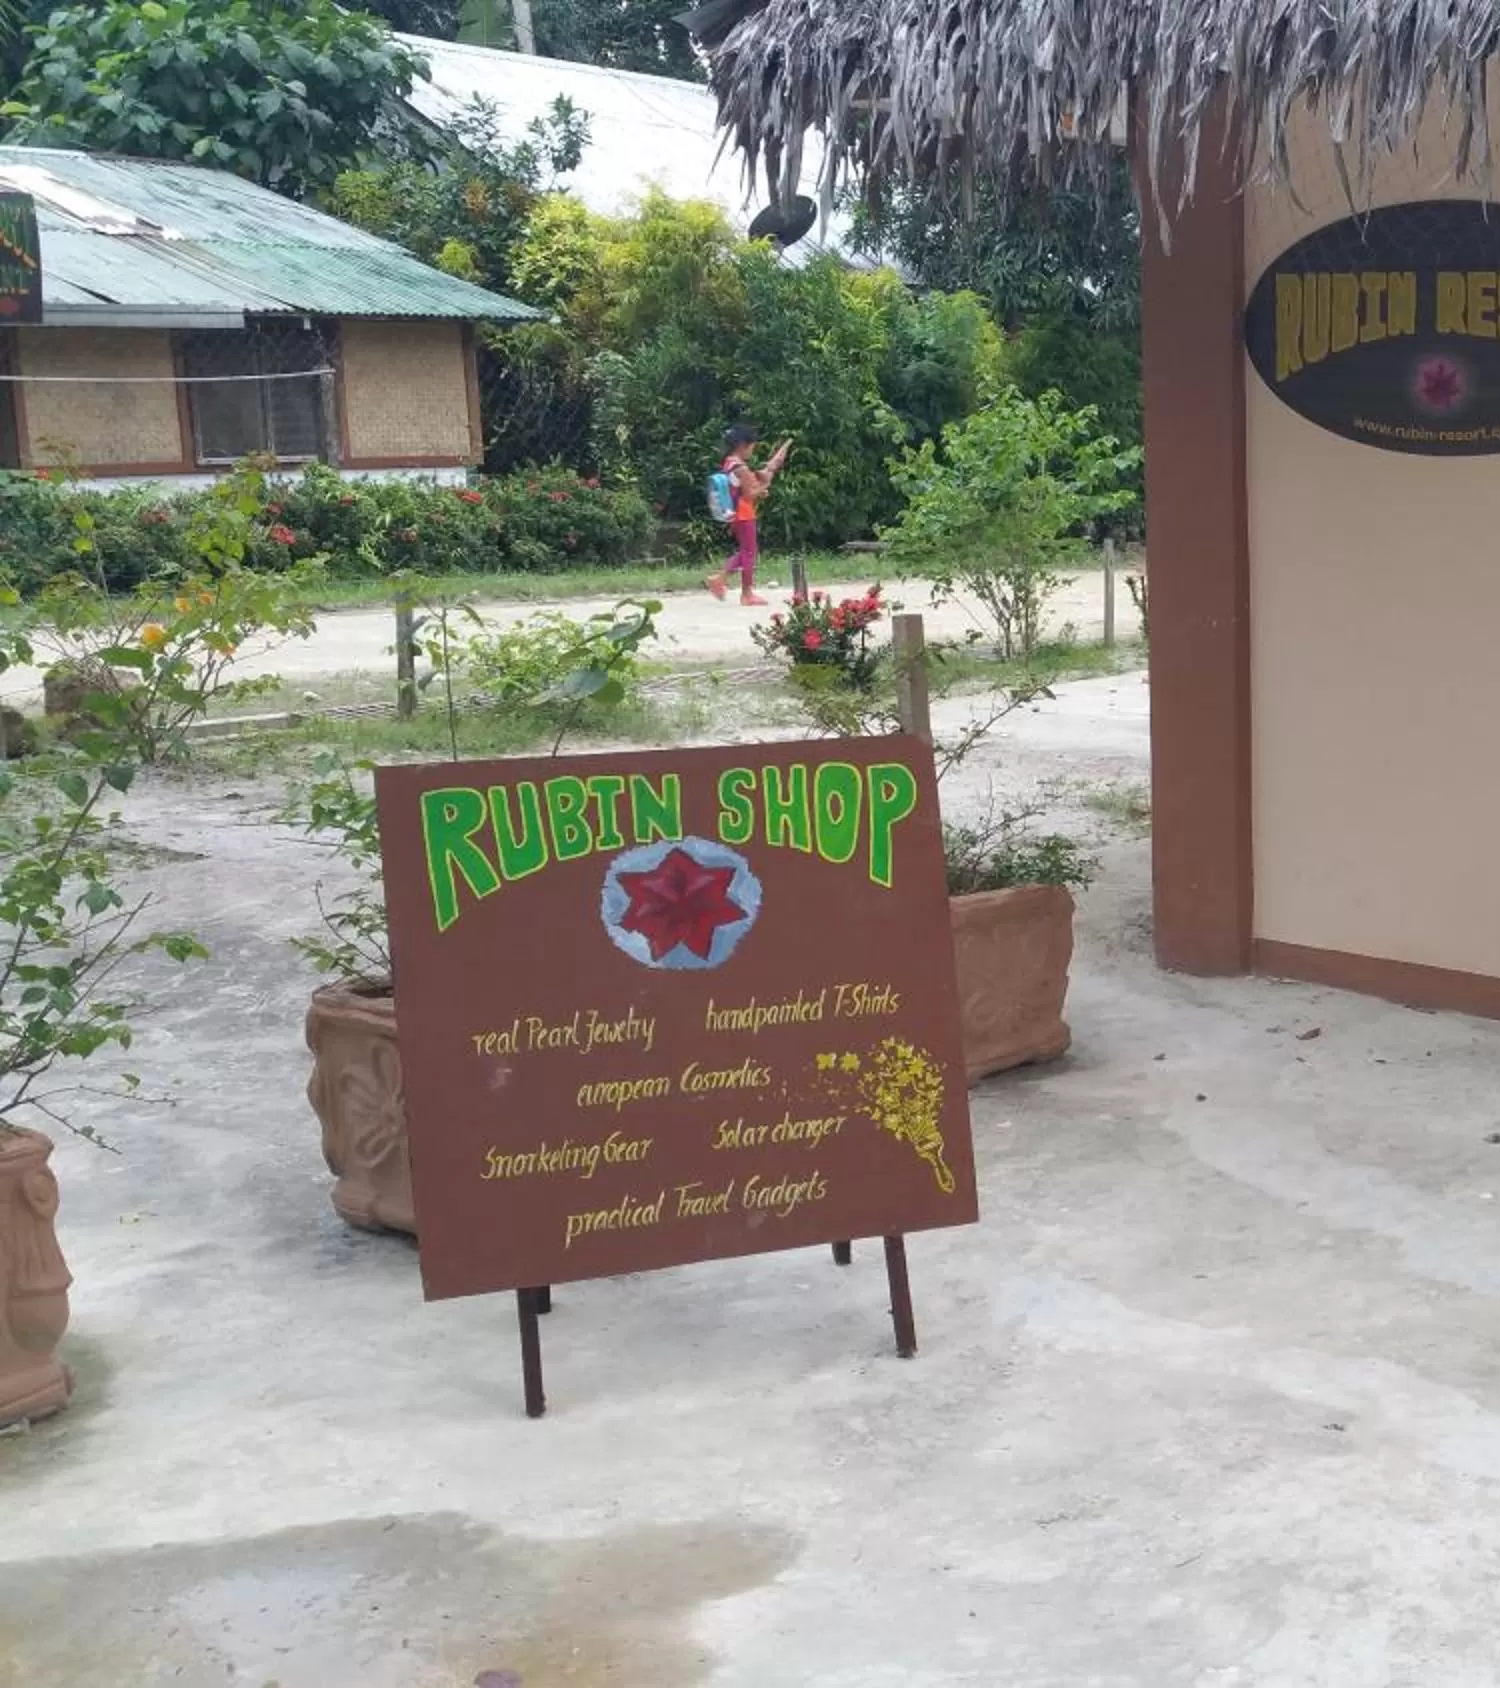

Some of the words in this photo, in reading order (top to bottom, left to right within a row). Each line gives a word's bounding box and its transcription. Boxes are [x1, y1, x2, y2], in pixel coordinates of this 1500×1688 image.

[1275, 271, 1417, 383] RUBIN
[420, 773, 683, 933] RUBIN
[718, 762, 917, 888] SHOP
[471, 1019, 520, 1056] real
[525, 1010, 580, 1050] Pearl
[579, 1006, 656, 1055] Jewelry
[705, 987, 826, 1034] handpainted
[833, 983, 900, 1017] T-Shirts
[576, 1074, 670, 1112] european
[679, 1056, 772, 1092] Cosmetics
[480, 1140, 601, 1179] Snorkeling
[603, 1130, 653, 1163] Gear
[565, 1191, 665, 1249] practical
[674, 1179, 735, 1218] Travel
[743, 1170, 828, 1218] Gadgets
